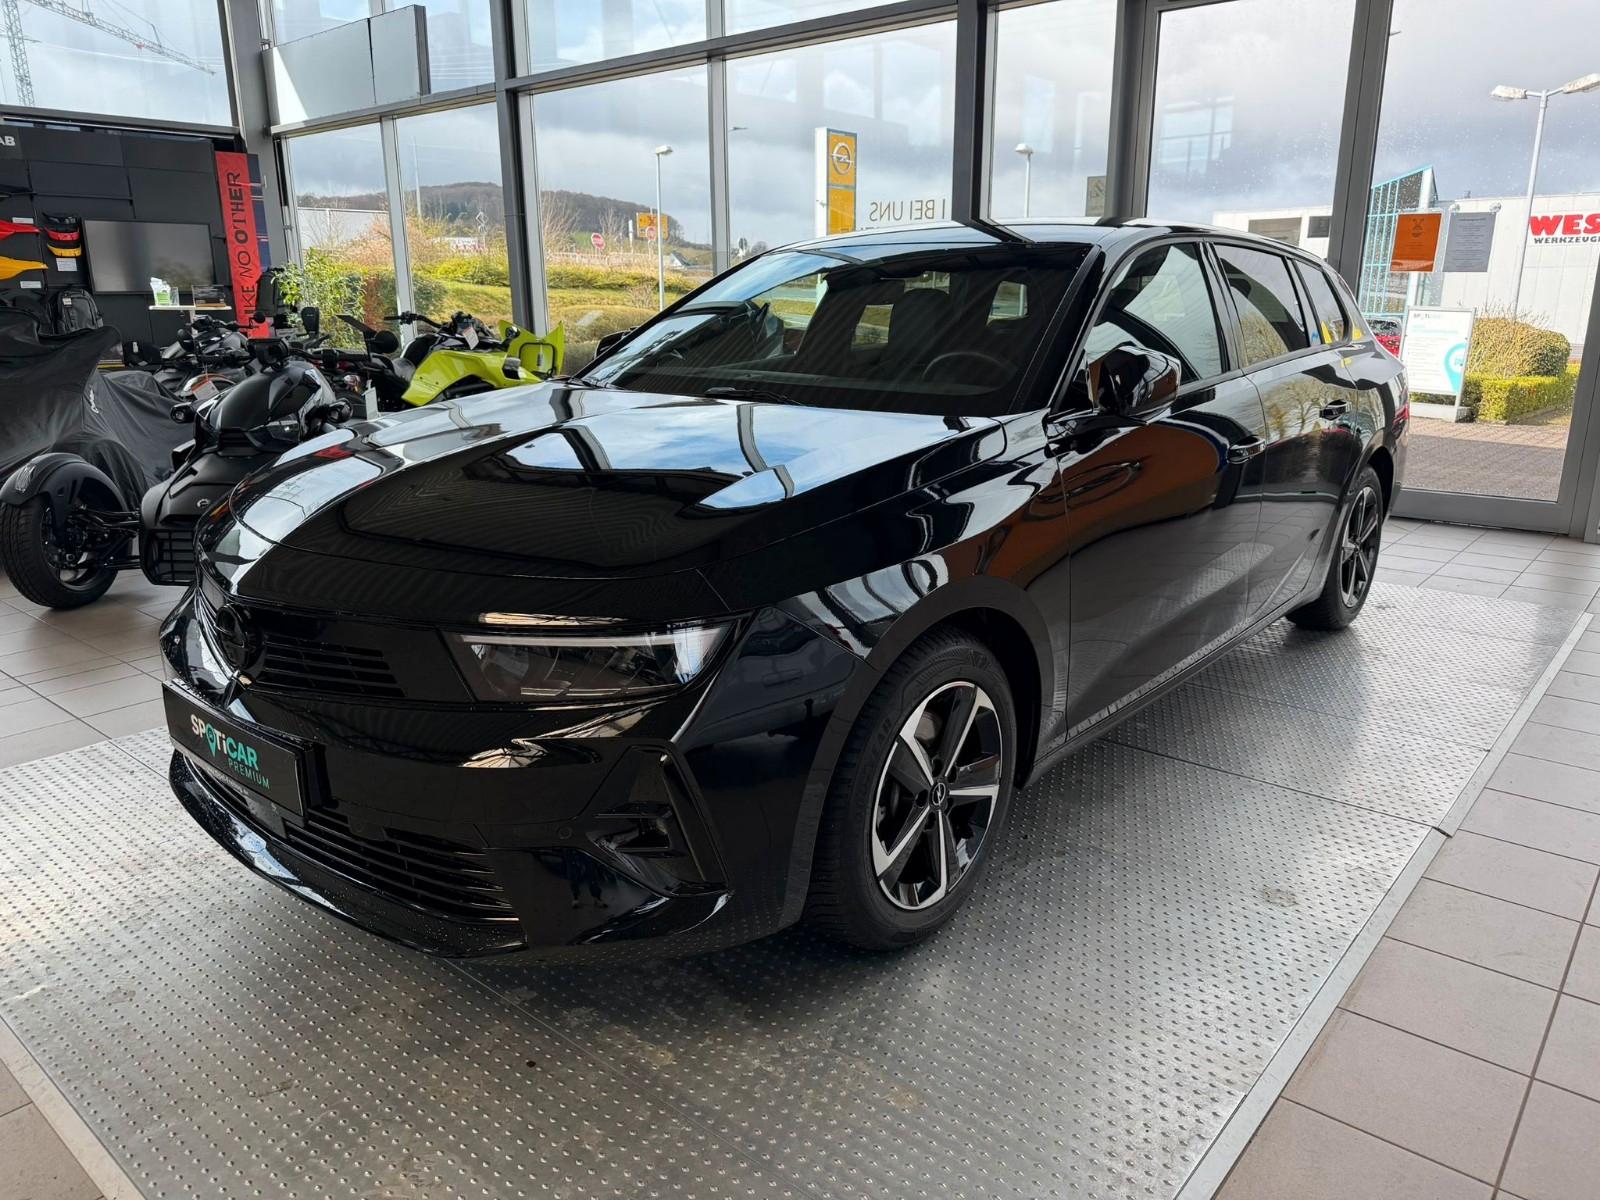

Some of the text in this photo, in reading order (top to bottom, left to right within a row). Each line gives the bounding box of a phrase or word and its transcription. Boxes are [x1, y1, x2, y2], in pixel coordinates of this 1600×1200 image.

[226, 172, 249, 245] OTHER
[1530, 213, 1600, 236] WES
[1533, 236, 1600, 244] WERKZEUG
[237, 250, 253, 279] NO
[228, 758, 271, 789] PREMIUM
